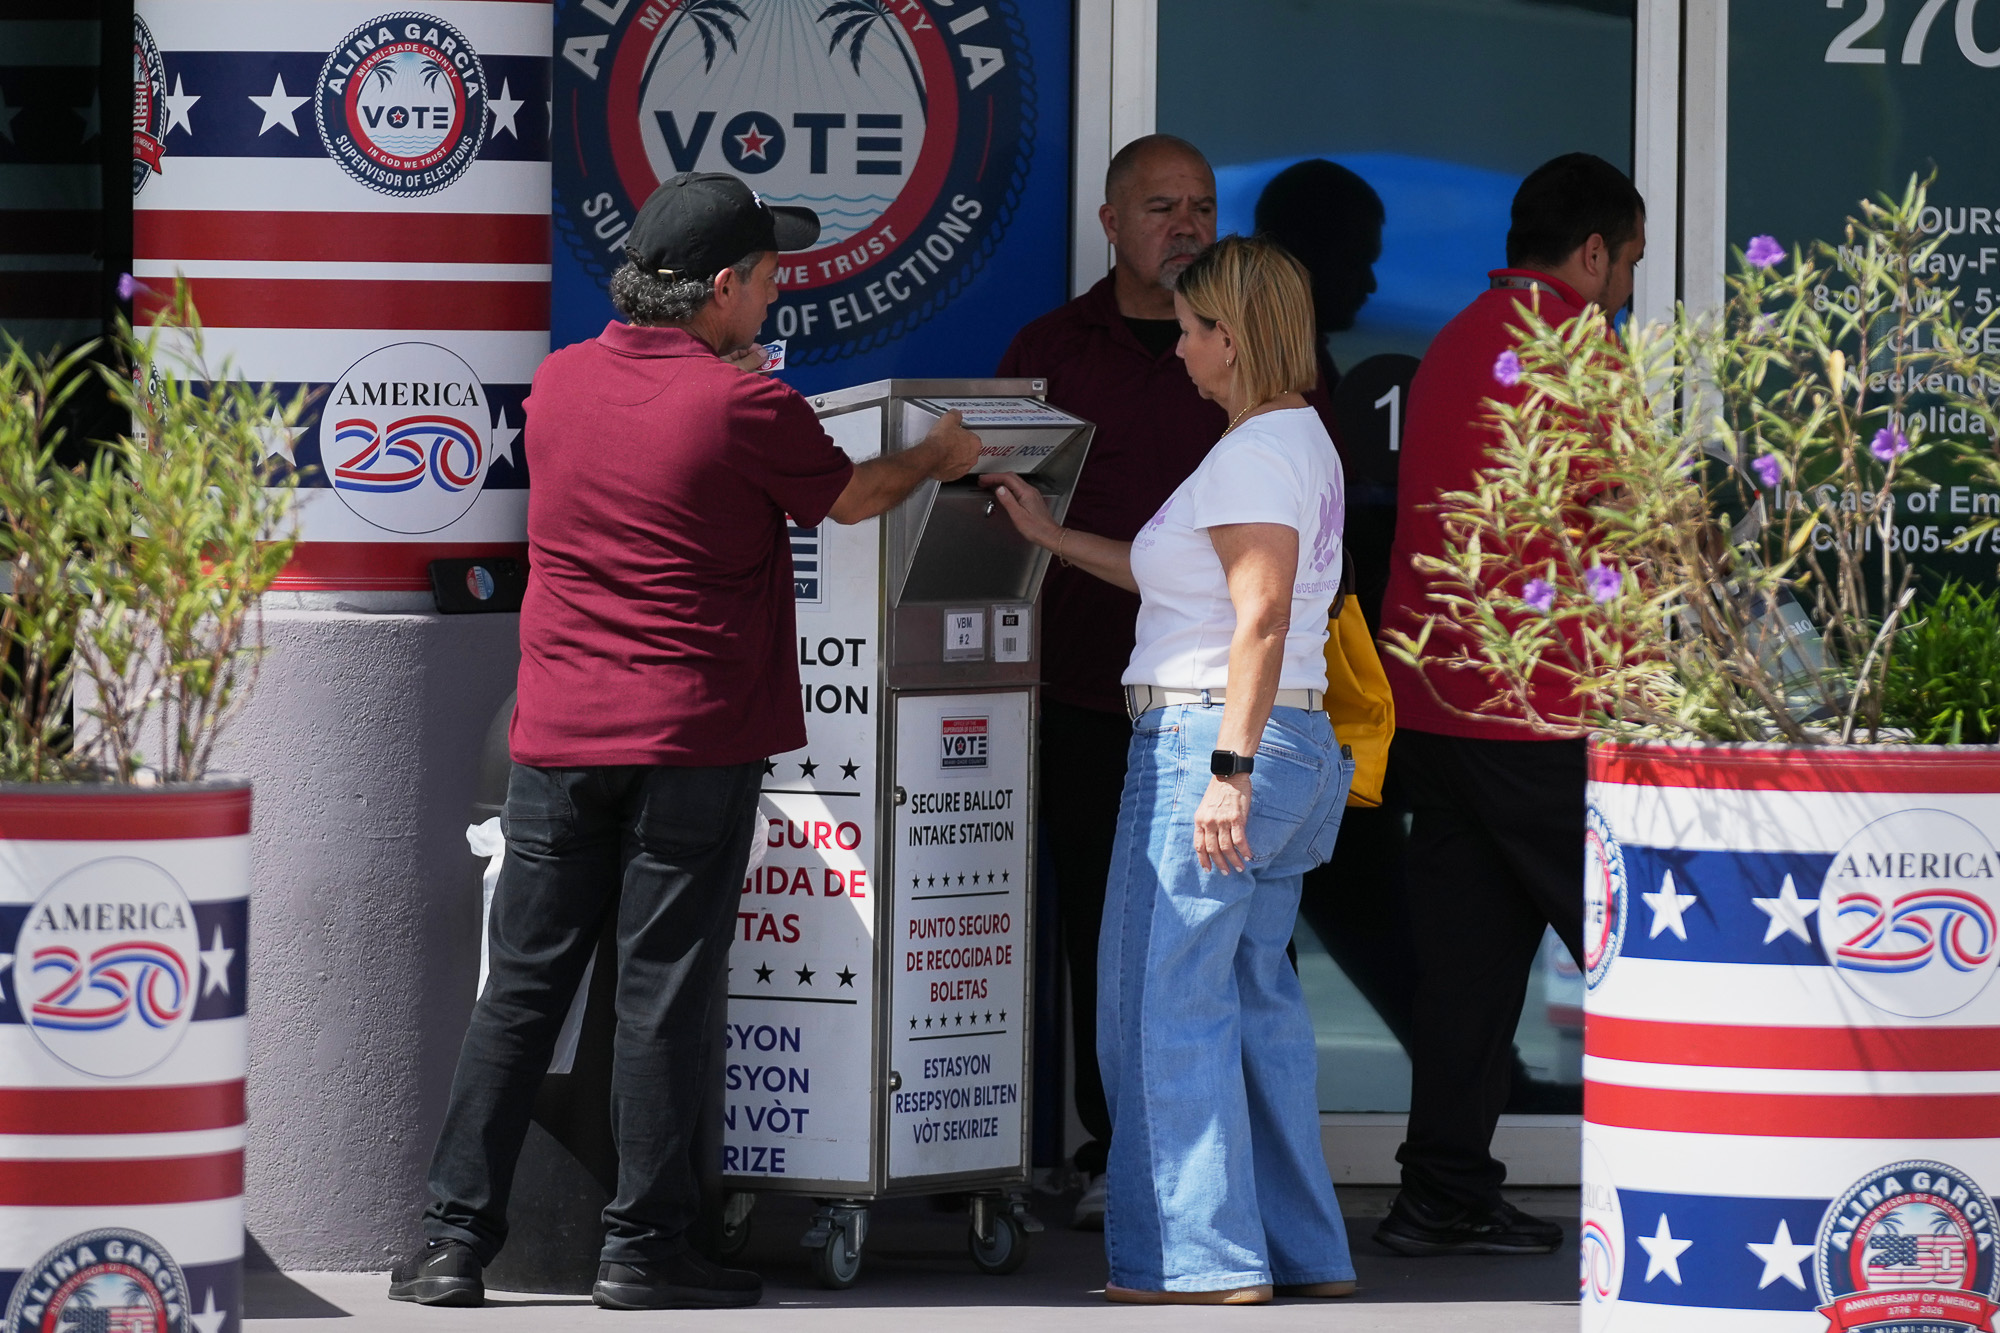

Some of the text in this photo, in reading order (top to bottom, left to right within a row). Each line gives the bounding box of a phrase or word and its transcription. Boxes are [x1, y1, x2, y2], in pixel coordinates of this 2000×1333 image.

[328, 24, 480, 98] ALINA GARCIA
[356, 44, 458, 78] MIAMI-DADE COUNTY
[362, 106, 448, 130] VOTE
[368, 146, 380, 158] IN
[380, 154, 400, 168] GOD
[420, 146, 448, 166] TRUST
[654, 110, 903, 175] VOTE
[336, 134, 473, 188] SUPERVISOR OF ELECTIONS
[776, 192, 983, 337] OF ELECTIONS
[818, 224, 898, 279] TRUST
[336, 382, 480, 407] AMERICA
[1374, 385, 1400, 450] 1
[335, 414, 482, 494] 250
[1016, 446, 1055, 456] POUSE
[1774, 484, 1802, 510] In
[1907, 485, 1941, 513] of
[956, 616, 972, 628] VBM
[800, 636, 866, 666] LOT
[943, 736, 987, 756] VOTE
[912, 789, 1014, 814] SECURE BALLOT
[768, 818, 862, 850] GURO
[909, 820, 1014, 846] INTAKE STATION
[1838, 852, 1994, 880] AMERICA
[824, 868, 866, 898] DE
[34, 902, 188, 934] AMERICA
[737, 912, 801, 944] TAS
[909, 912, 1011, 940] PUNTO SEGURO
[1837, 888, 1997, 974] 250
[906, 945, 1012, 972] DE RECOGIDA DE
[33, 940, 190, 1031] 250
[930, 978, 988, 1002] BOLETAS
[726, 1064, 810, 1094] SYON
[924, 1054, 990, 1079] ESTASYON
[896, 1083, 1017, 1114] RESEPSYON BILTEN
[744, 1099, 810, 1134] VÒT
[913, 1116, 998, 1144] VÒT SEKIRIZE
[724, 1144, 786, 1173] RIZE
[1832, 1172, 1992, 1252] ALINA GARCIA
[1856, 1194, 1912, 1241] SUPERVISOR
[1931, 1194, 1972, 1241] ELECTIONS
[22, 1240, 182, 1326] ALINA GARCIA
[1844, 1293, 1981, 1312] ANNIVERSARY OF AMERICA
[1888, 1306, 1911, 1315] 1776
[1919, 1306, 1944, 1315] 2026
